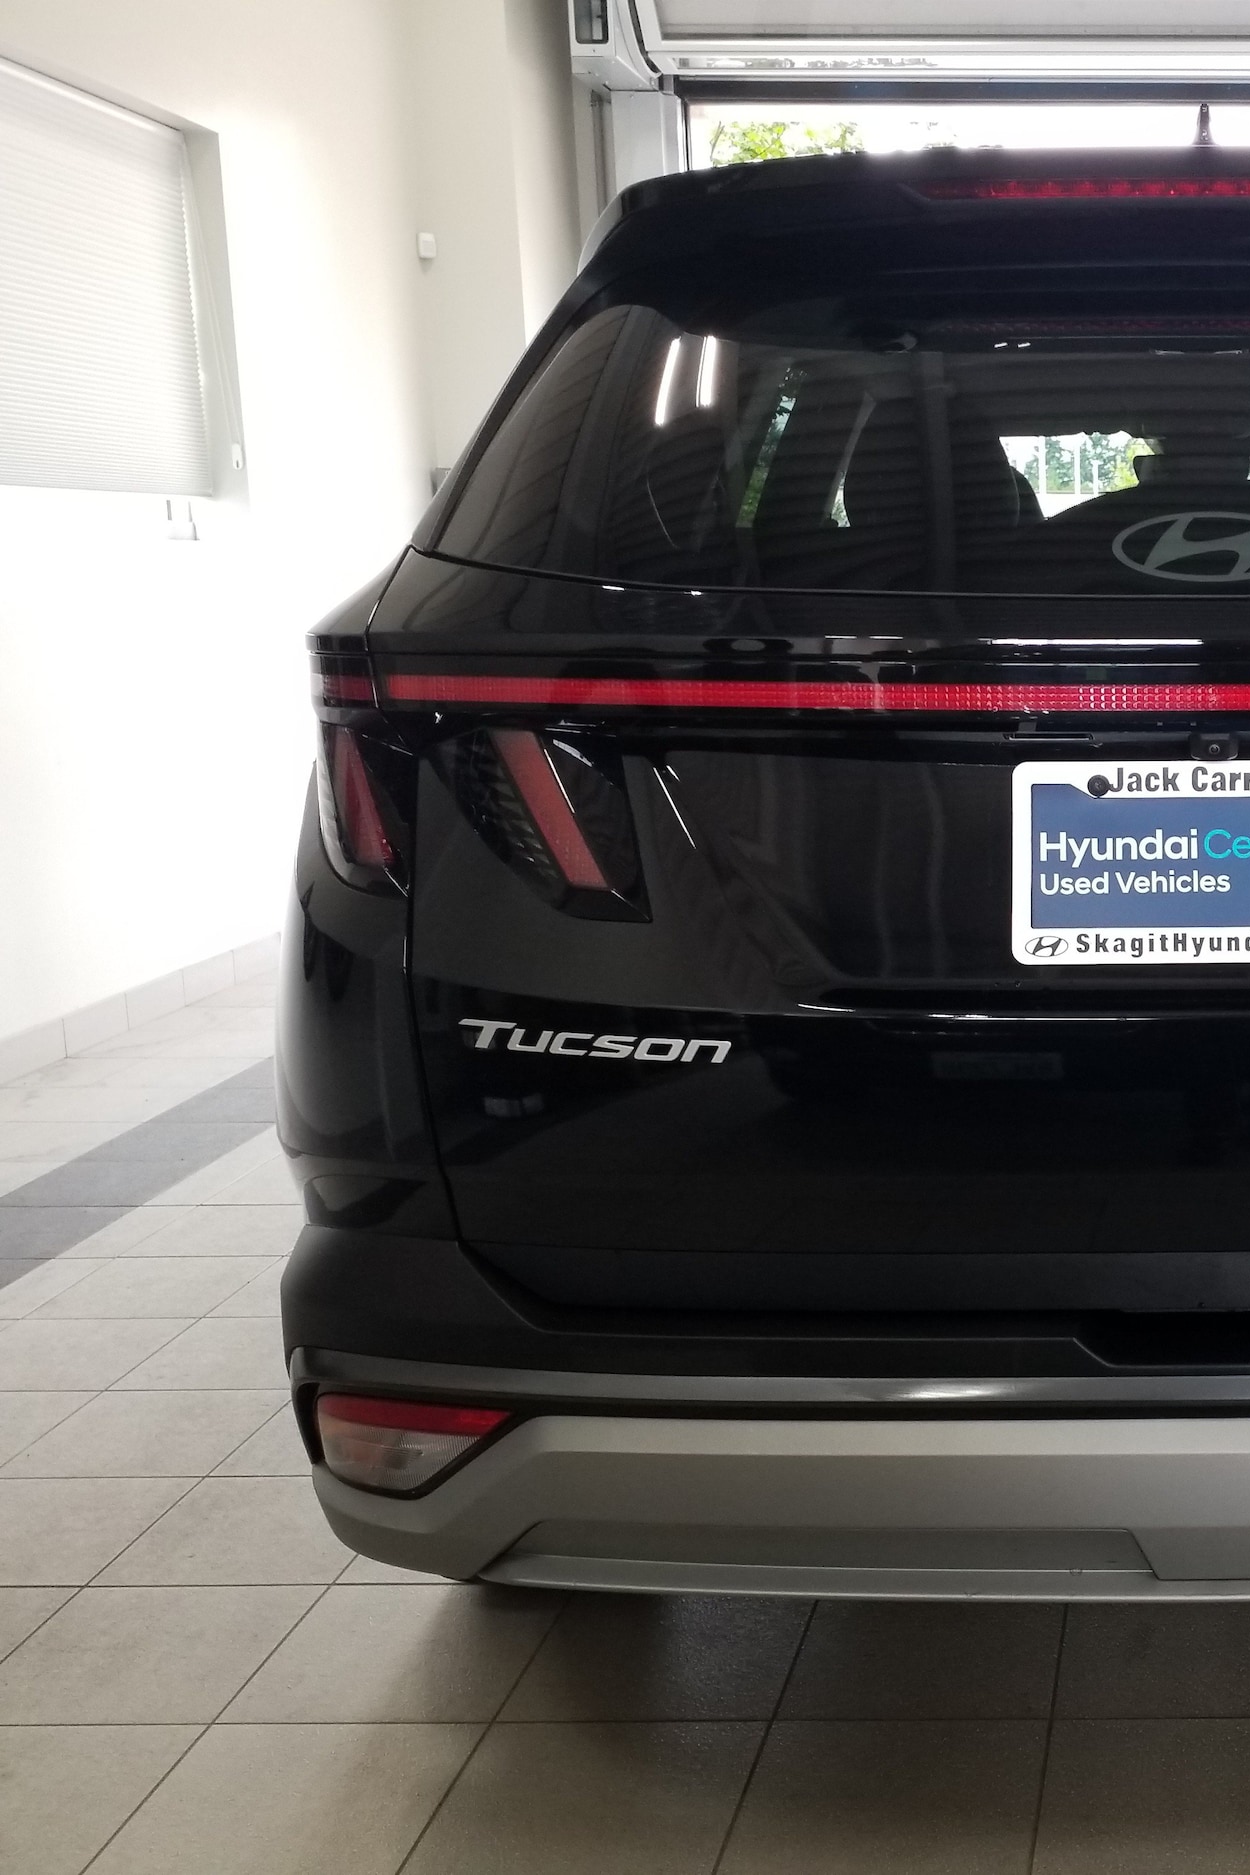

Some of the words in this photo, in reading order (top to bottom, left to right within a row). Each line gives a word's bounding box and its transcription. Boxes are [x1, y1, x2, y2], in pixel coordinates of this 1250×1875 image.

[1108, 766, 1180, 793] Jack
[1039, 828, 1199, 868] Hyundai
[1039, 871, 1110, 896] Used
[1115, 869, 1232, 895] Vehicles
